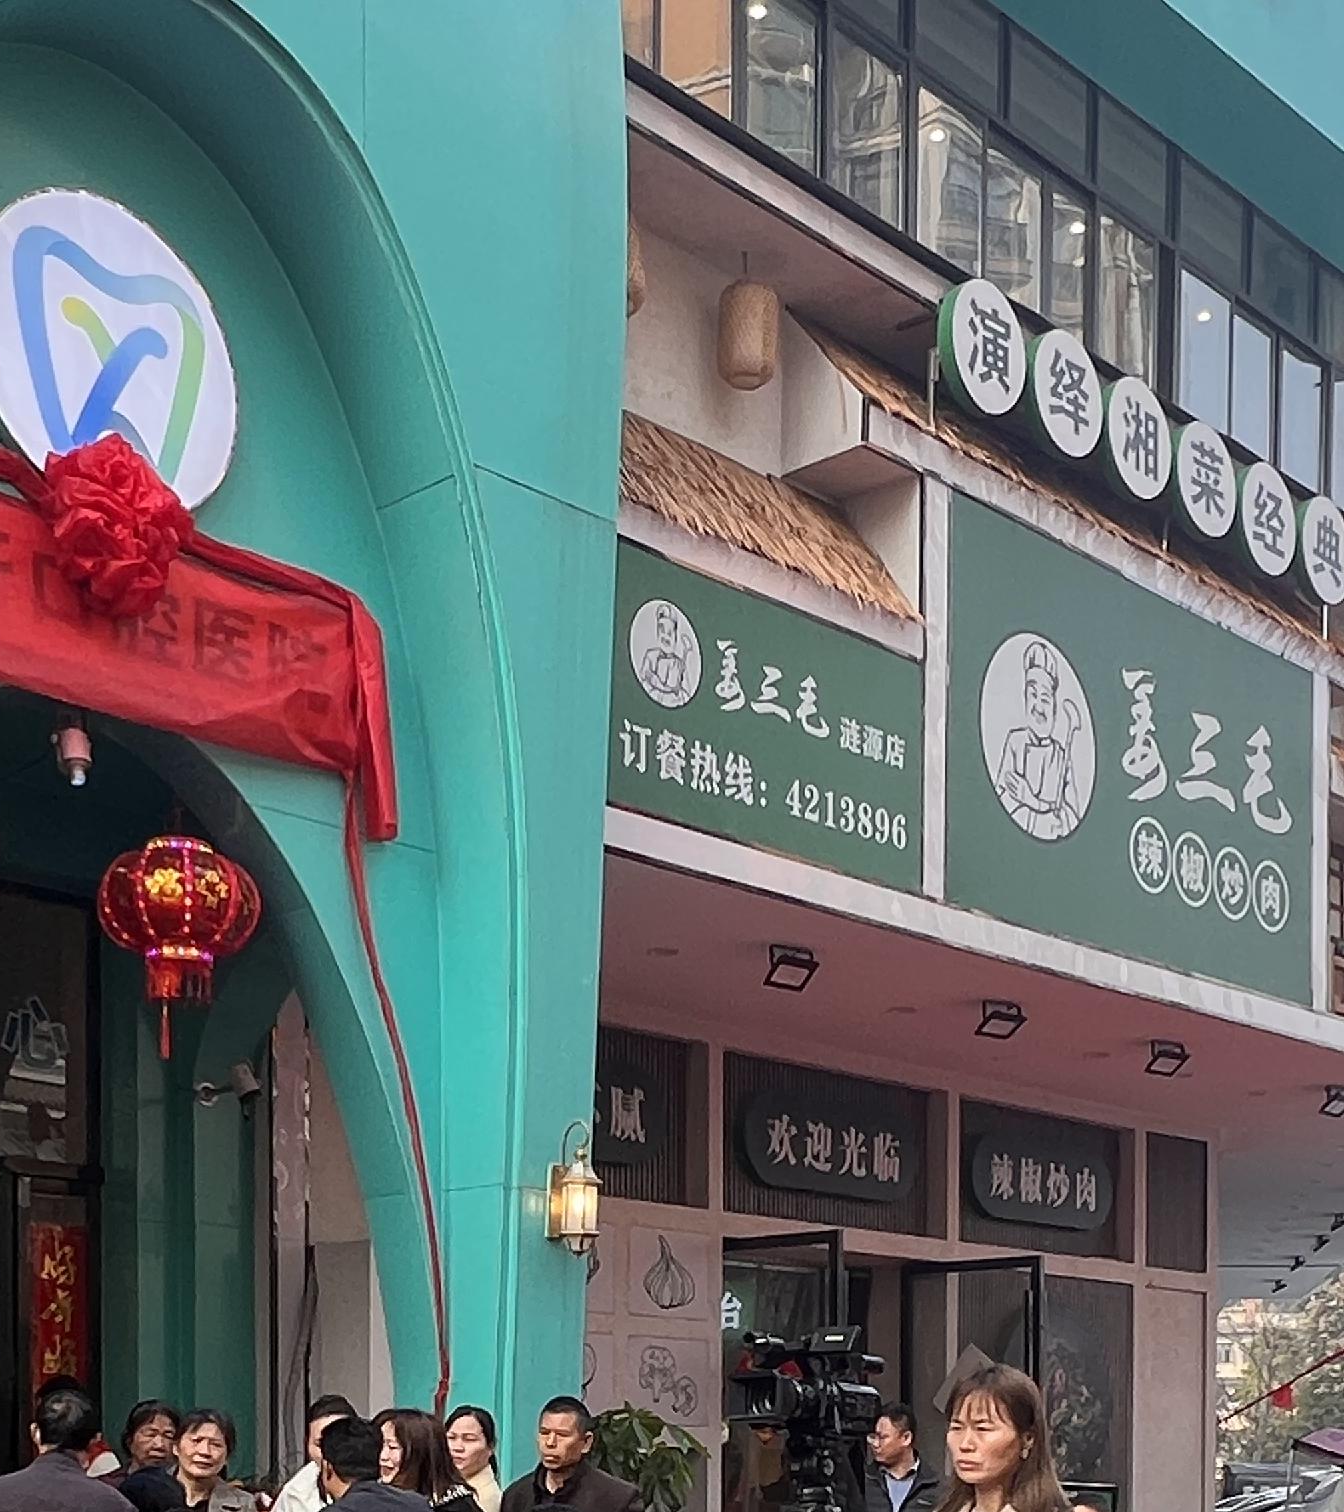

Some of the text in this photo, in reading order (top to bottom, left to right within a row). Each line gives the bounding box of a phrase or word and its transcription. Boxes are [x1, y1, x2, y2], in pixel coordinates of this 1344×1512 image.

[968, 301, 1342, 587] 演绎湘菜经典
[839, 716, 906, 770] 涟源店
[1137, 830, 1281, 919] 辣椒炒肉
[767, 1114, 901, 1183] 欢迎光临
[990, 1153, 1096, 1212] 辣椒炒肉
